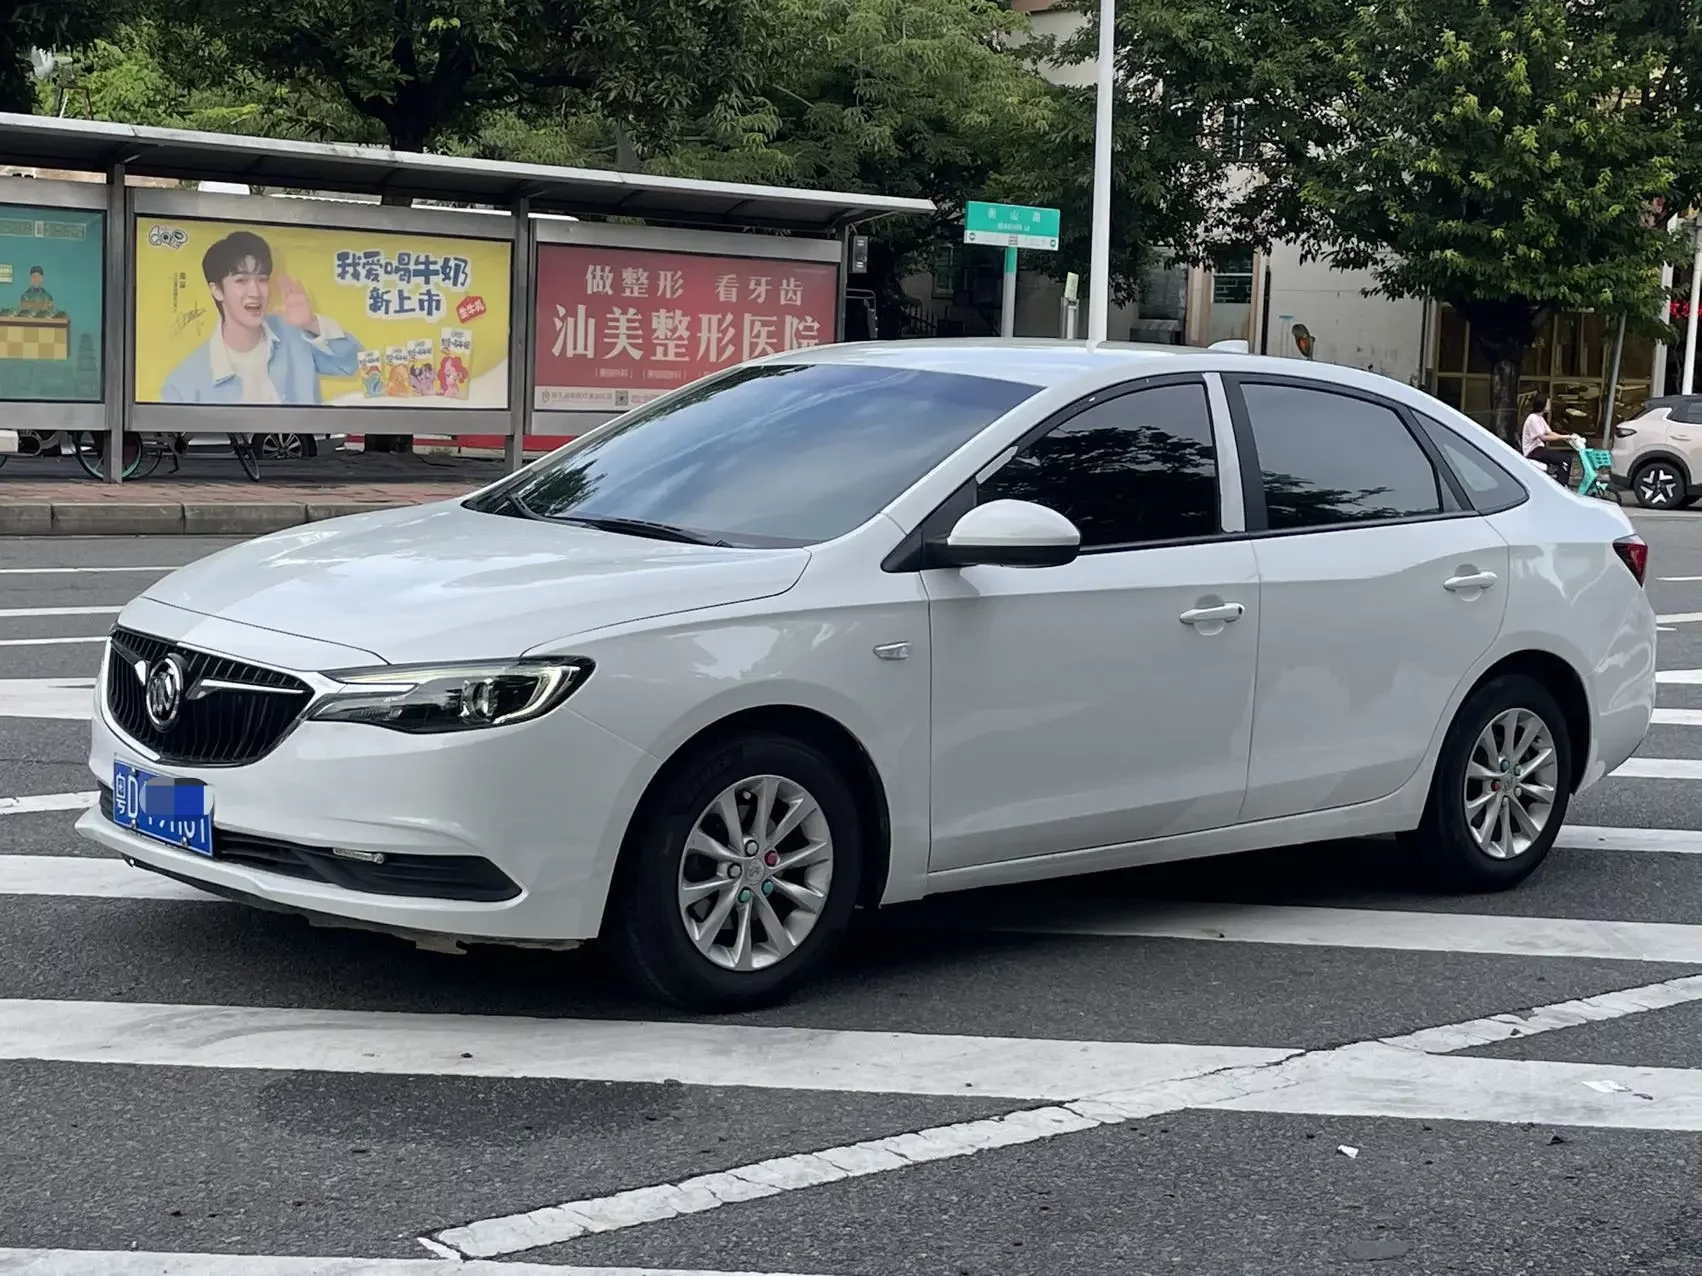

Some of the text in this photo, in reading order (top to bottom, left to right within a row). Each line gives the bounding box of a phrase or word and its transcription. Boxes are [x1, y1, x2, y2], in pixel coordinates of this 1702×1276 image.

[336, 250, 469, 287] 我爱喝牛奶
[585, 264, 804, 305] 做整形 看牙齿
[369, 286, 441, 317] 新上市
[551, 304, 821, 362] 汕美整形医院
